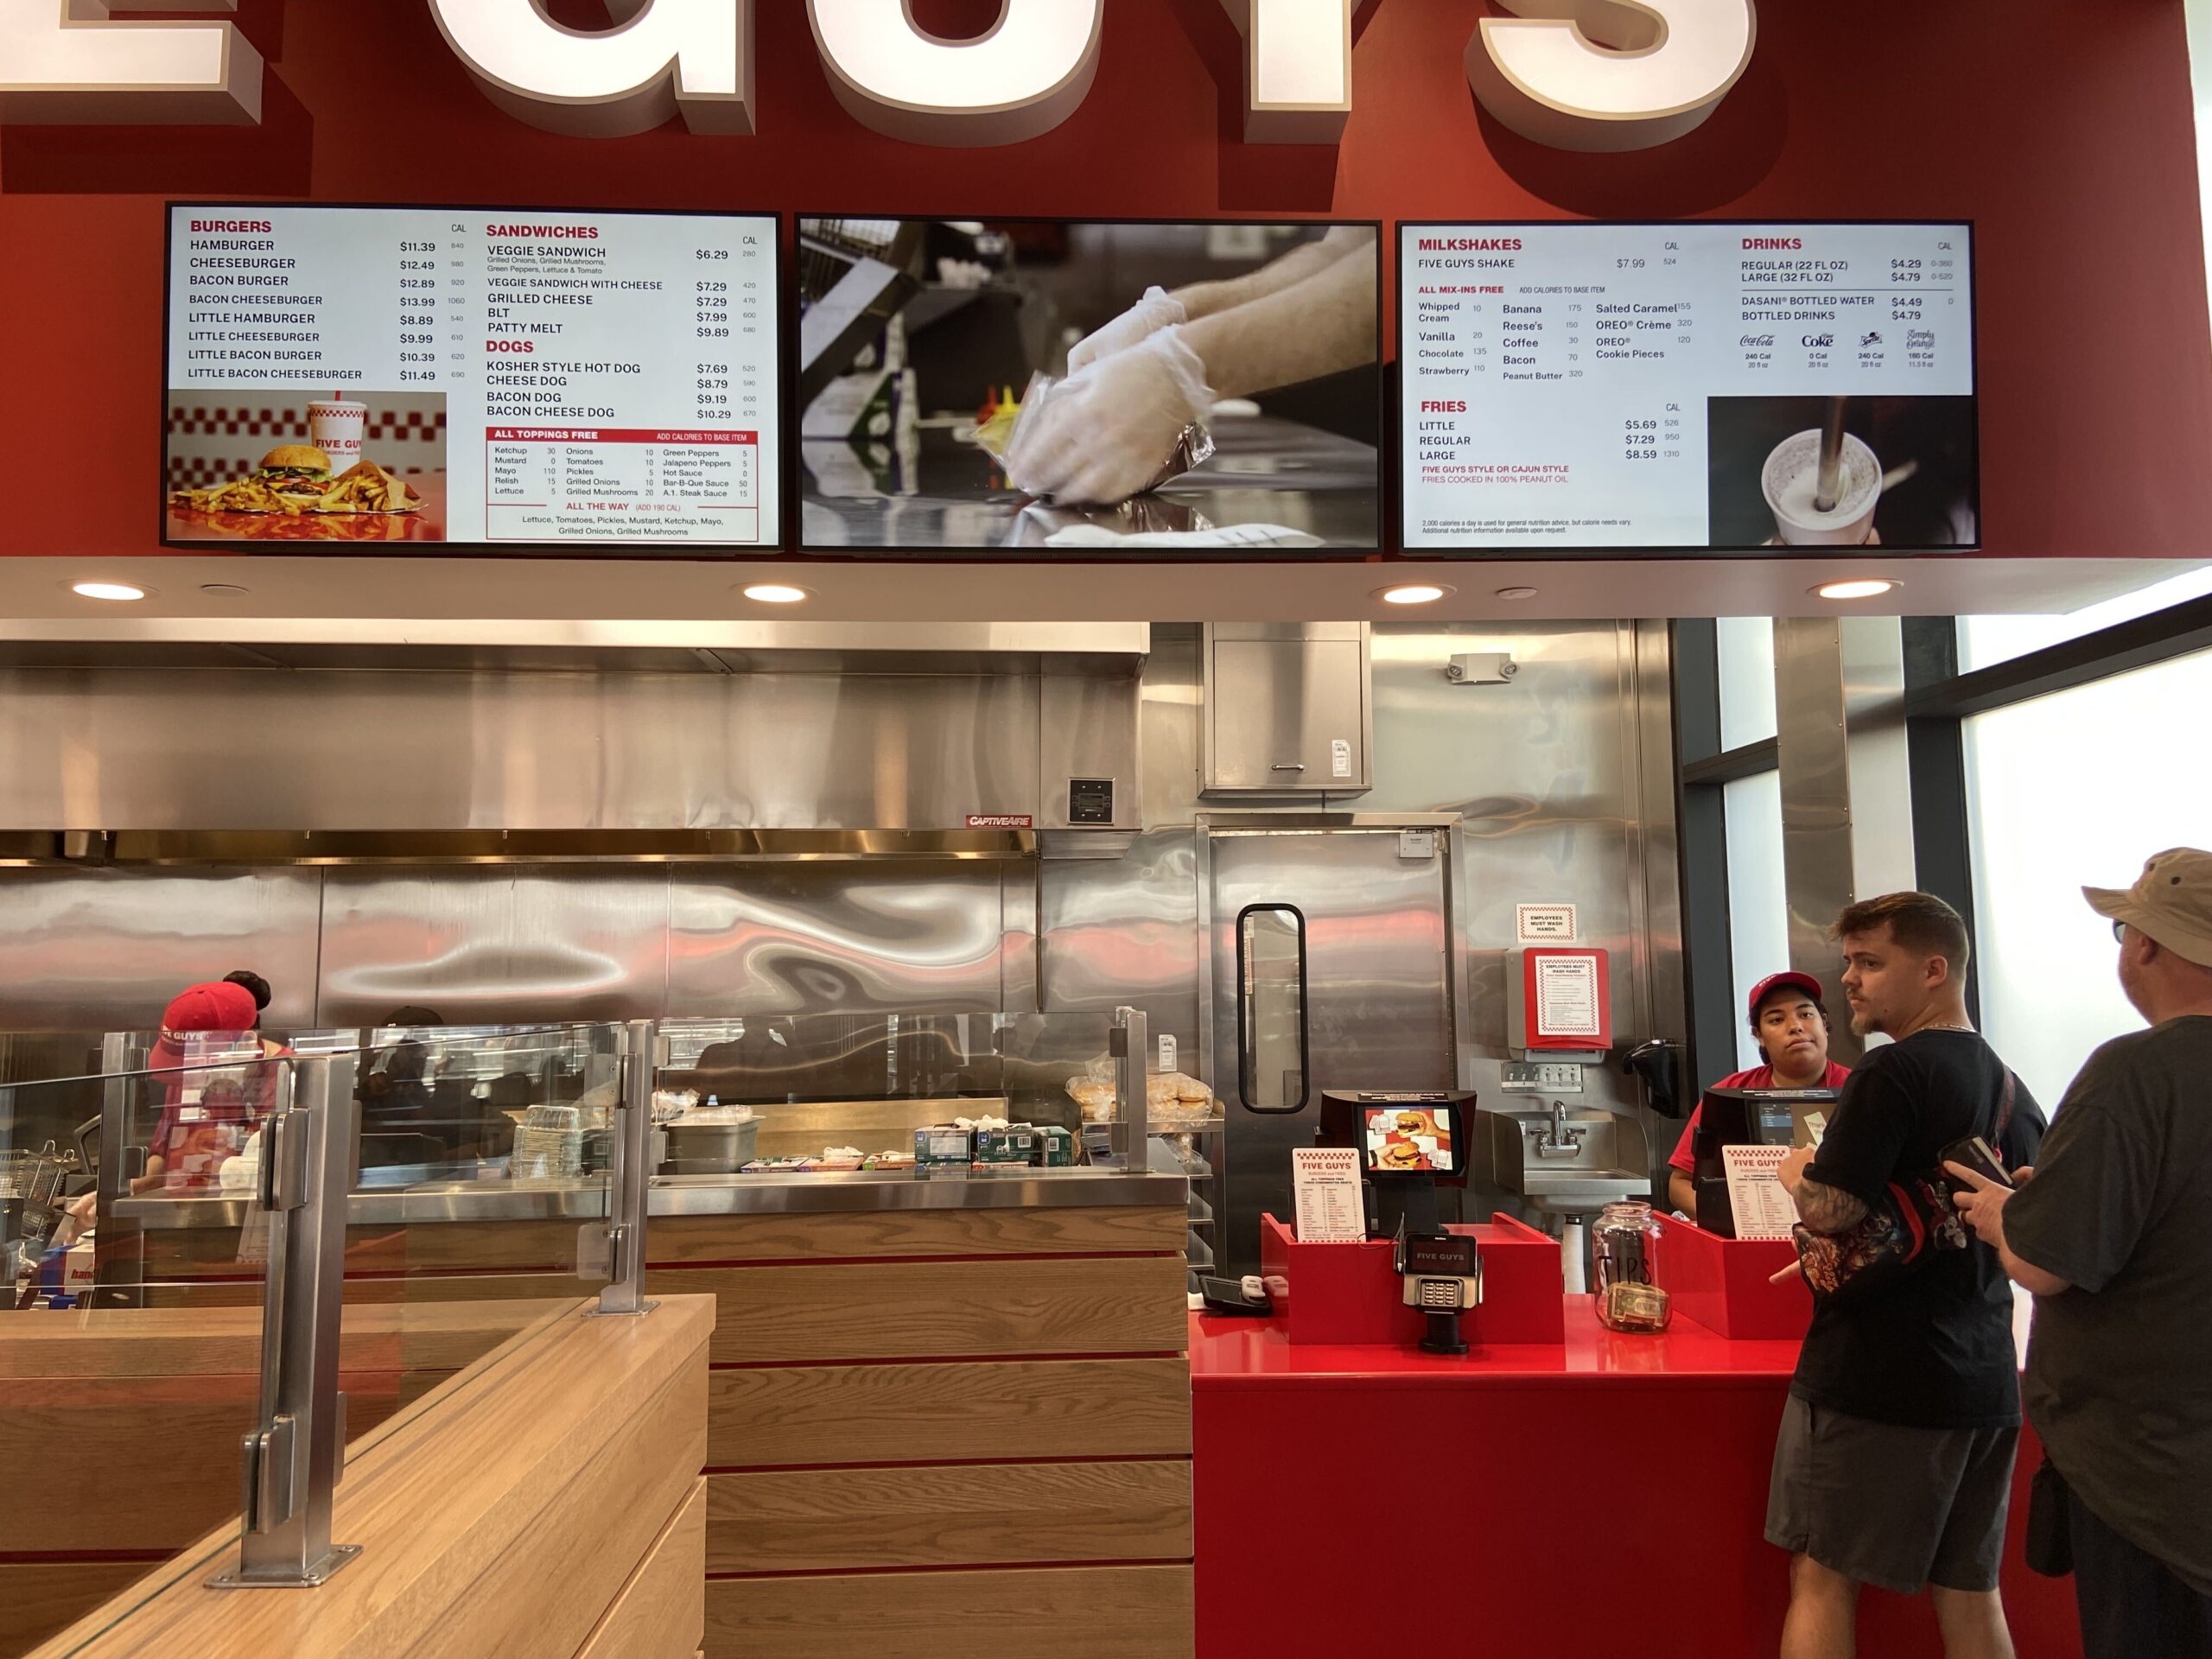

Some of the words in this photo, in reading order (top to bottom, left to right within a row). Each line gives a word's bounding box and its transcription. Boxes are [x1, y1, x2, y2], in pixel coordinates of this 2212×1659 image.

[190, 220, 272, 232] BURGERS
[451, 224, 467, 232] CAL
[486, 225, 598, 238] SANDWICHES
[190, 240, 274, 251] HAMBURGER
[742, 236, 757, 245] CAL
[1419, 239, 1522, 251] MILKSHAKES
[1742, 238, 1802, 250] DRINKS
[400, 242, 435, 252] $11.39
[487, 245, 534, 256] VEGGIE
[537, 246, 606, 257] SANDWICH
[1665, 242, 1679, 251] CAL
[696, 250, 728, 260] $6.29
[190, 257, 296, 269] CHEESEBURGER
[400, 261, 435, 270] $12.49
[1617, 258, 1644, 269] $7.99
[1742, 262, 1792, 270] REGULAR
[1796, 261, 1812, 271] (22
[1815, 261, 1827, 270] FL
[1830, 261, 1848, 270] OZ)
[1891, 259, 1921, 269] $4.29
[189, 276, 234, 285] BACON
[238, 276, 289, 286] BURGER
[1742, 274, 1777, 283] LARGE
[1780, 273, 1797, 283] (32
[1801, 273, 1813, 282] FL
[1815, 273, 1833, 283] OZ)
[1891, 273, 1920, 282] $4.79
[400, 279, 435, 289] $12.89
[487, 278, 526, 287] VEGGIE
[530, 279, 588, 289] SANDWICH
[591, 280, 618, 289] WITH
[620, 281, 663, 289] CHEESE
[696, 282, 727, 292] $7.29
[189, 296, 229, 304] BACON
[232, 296, 322, 305] CHEESEBURGER
[400, 297, 435, 307] $13.99
[487, 294, 540, 303] GRILLED
[543, 295, 593, 304] CHEESE
[696, 297, 727, 307] $7.29
[1891, 297, 1922, 307] $4.49
[488, 308, 510, 317] BLT
[1419, 302, 1459, 313] Whipped
[1503, 305, 1541, 314] Banana
[1596, 304, 1630, 313] Salted
[1633, 304, 1678, 313] Caramel
[189, 313, 231, 323] LITTLE
[234, 314, 315, 324] HAMBURGER
[400, 315, 434, 326] $8.89
[696, 312, 727, 322] $7.99
[1742, 312, 1791, 321] BOTTLED
[1891, 311, 1921, 321] $4.79
[488, 323, 526, 333] PATTY
[531, 324, 563, 334] MELT
[1503, 321, 1542, 330] Reese's
[188, 332, 226, 340] LITTLE
[228, 332, 320, 342] CHEESEBURGER
[696, 327, 728, 337] $9.89
[1419, 333, 1455, 341] Vanilla
[400, 334, 433, 344] $9.99
[1503, 338, 1538, 347] Coffee
[1802, 335, 1834, 347] Coke
[486, 340, 533, 353] DOGS
[188, 351, 226, 359] LITTLE
[230, 351, 270, 360] BACON
[274, 351, 321, 360] BURGER
[400, 353, 435, 362] $10.39
[1419, 349, 1464, 358] Chocolate
[1596, 350, 1630, 359] Cookie
[1632, 350, 1664, 359] Pieces
[486, 361, 539, 372] KOSHER
[543, 362, 581, 372] STYLE
[585, 363, 611, 372] HOT
[614, 364, 640, 373] DOG
[697, 364, 728, 374] $7.69
[1419, 366, 1469, 376] Strawberry
[188, 369, 225, 378] LITTLE
[228, 369, 267, 378] BACON
[270, 370, 362, 379] CHEESEBURGER
[400, 371, 435, 381] $11.49
[486, 376, 537, 385] CHEESE
[540, 377, 567, 386] DOG
[697, 379, 728, 389] $8.79
[487, 392, 531, 402] BACON
[535, 392, 562, 403] DOG
[697, 394, 727, 404] $9.19
[1421, 401, 1466, 412] FRIES
[1666, 404, 1680, 412] CAL
[487, 407, 531, 416] BACON
[535, 407, 583, 416] CHEESE
[588, 408, 614, 417] DOG
[697, 410, 731, 419] $10.29
[1420, 422, 1455, 430] LITTLE
[1625, 421, 1656, 429] $5.69
[517, 430, 569, 439] TOPPINGS
[1626, 435, 1655, 444] $7.29
[1420, 436, 1471, 445] REGULAR
[495, 447, 527, 455] Ketchup
[1420, 451, 1455, 460] LARGE
[1626, 450, 1656, 460] $8.59
[1599, 1256, 1651, 1285] TIPS
